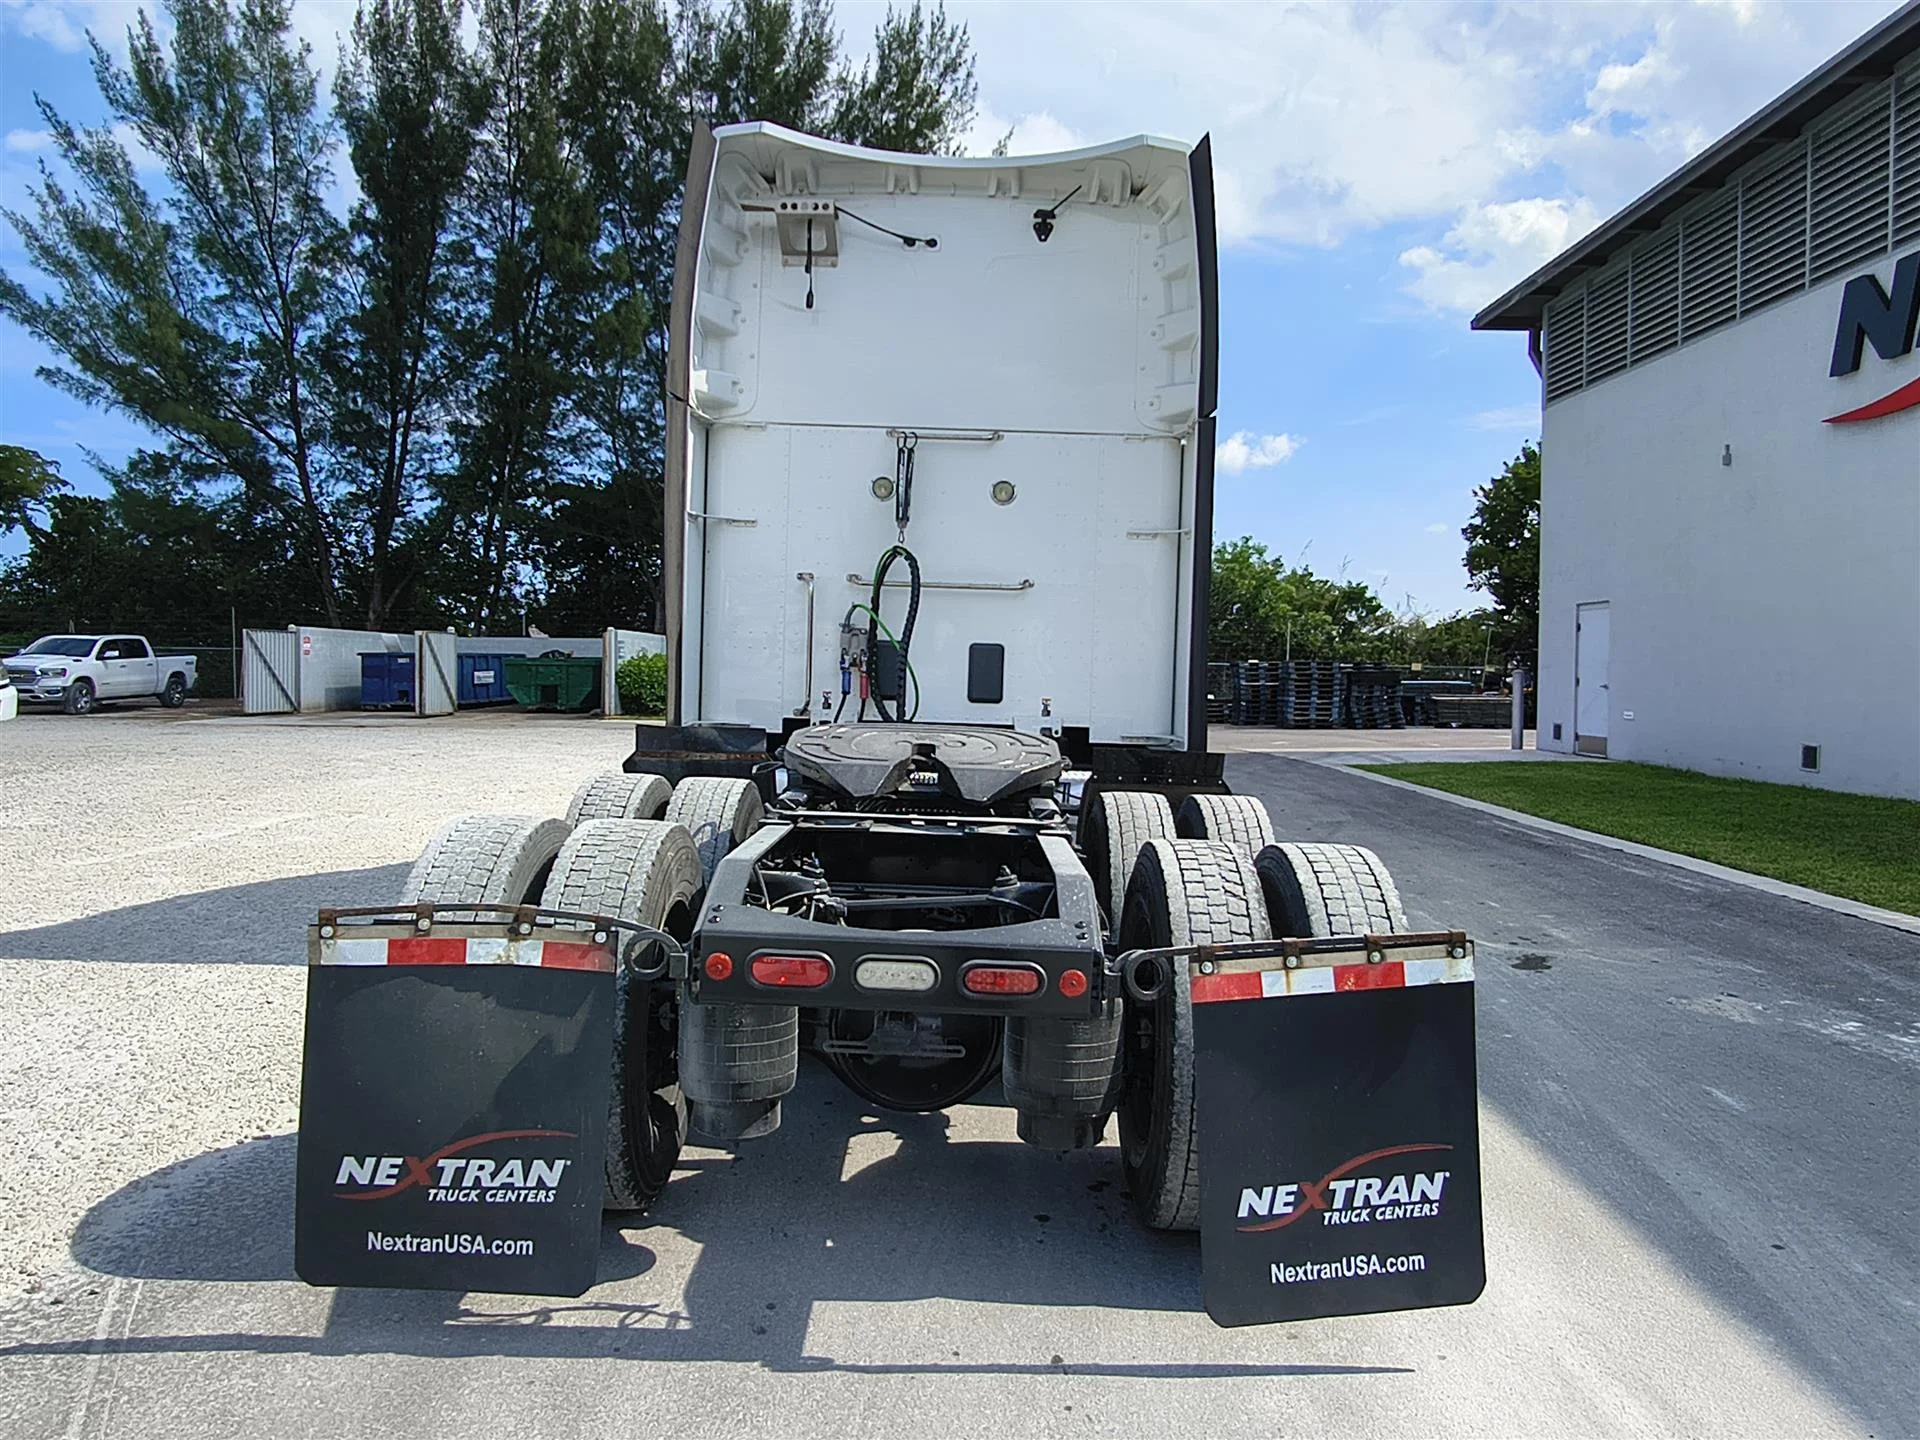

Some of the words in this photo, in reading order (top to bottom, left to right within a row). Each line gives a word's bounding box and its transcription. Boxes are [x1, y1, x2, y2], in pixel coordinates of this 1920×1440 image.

[1829, 250, 1920, 378] N
[335, 1154, 566, 1189] NEXTRAN
[427, 1188, 480, 1202] TRUCK
[485, 1189, 557, 1203] CENTERS
[1237, 1171, 1446, 1218] NEXTRAN
[1322, 1207, 1371, 1226] TRUCK
[1375, 1201, 1440, 1221] CENTERS
[367, 1230, 534, 1256] NextranUSA.com
[1270, 1252, 1426, 1284] NextranUSA.com
